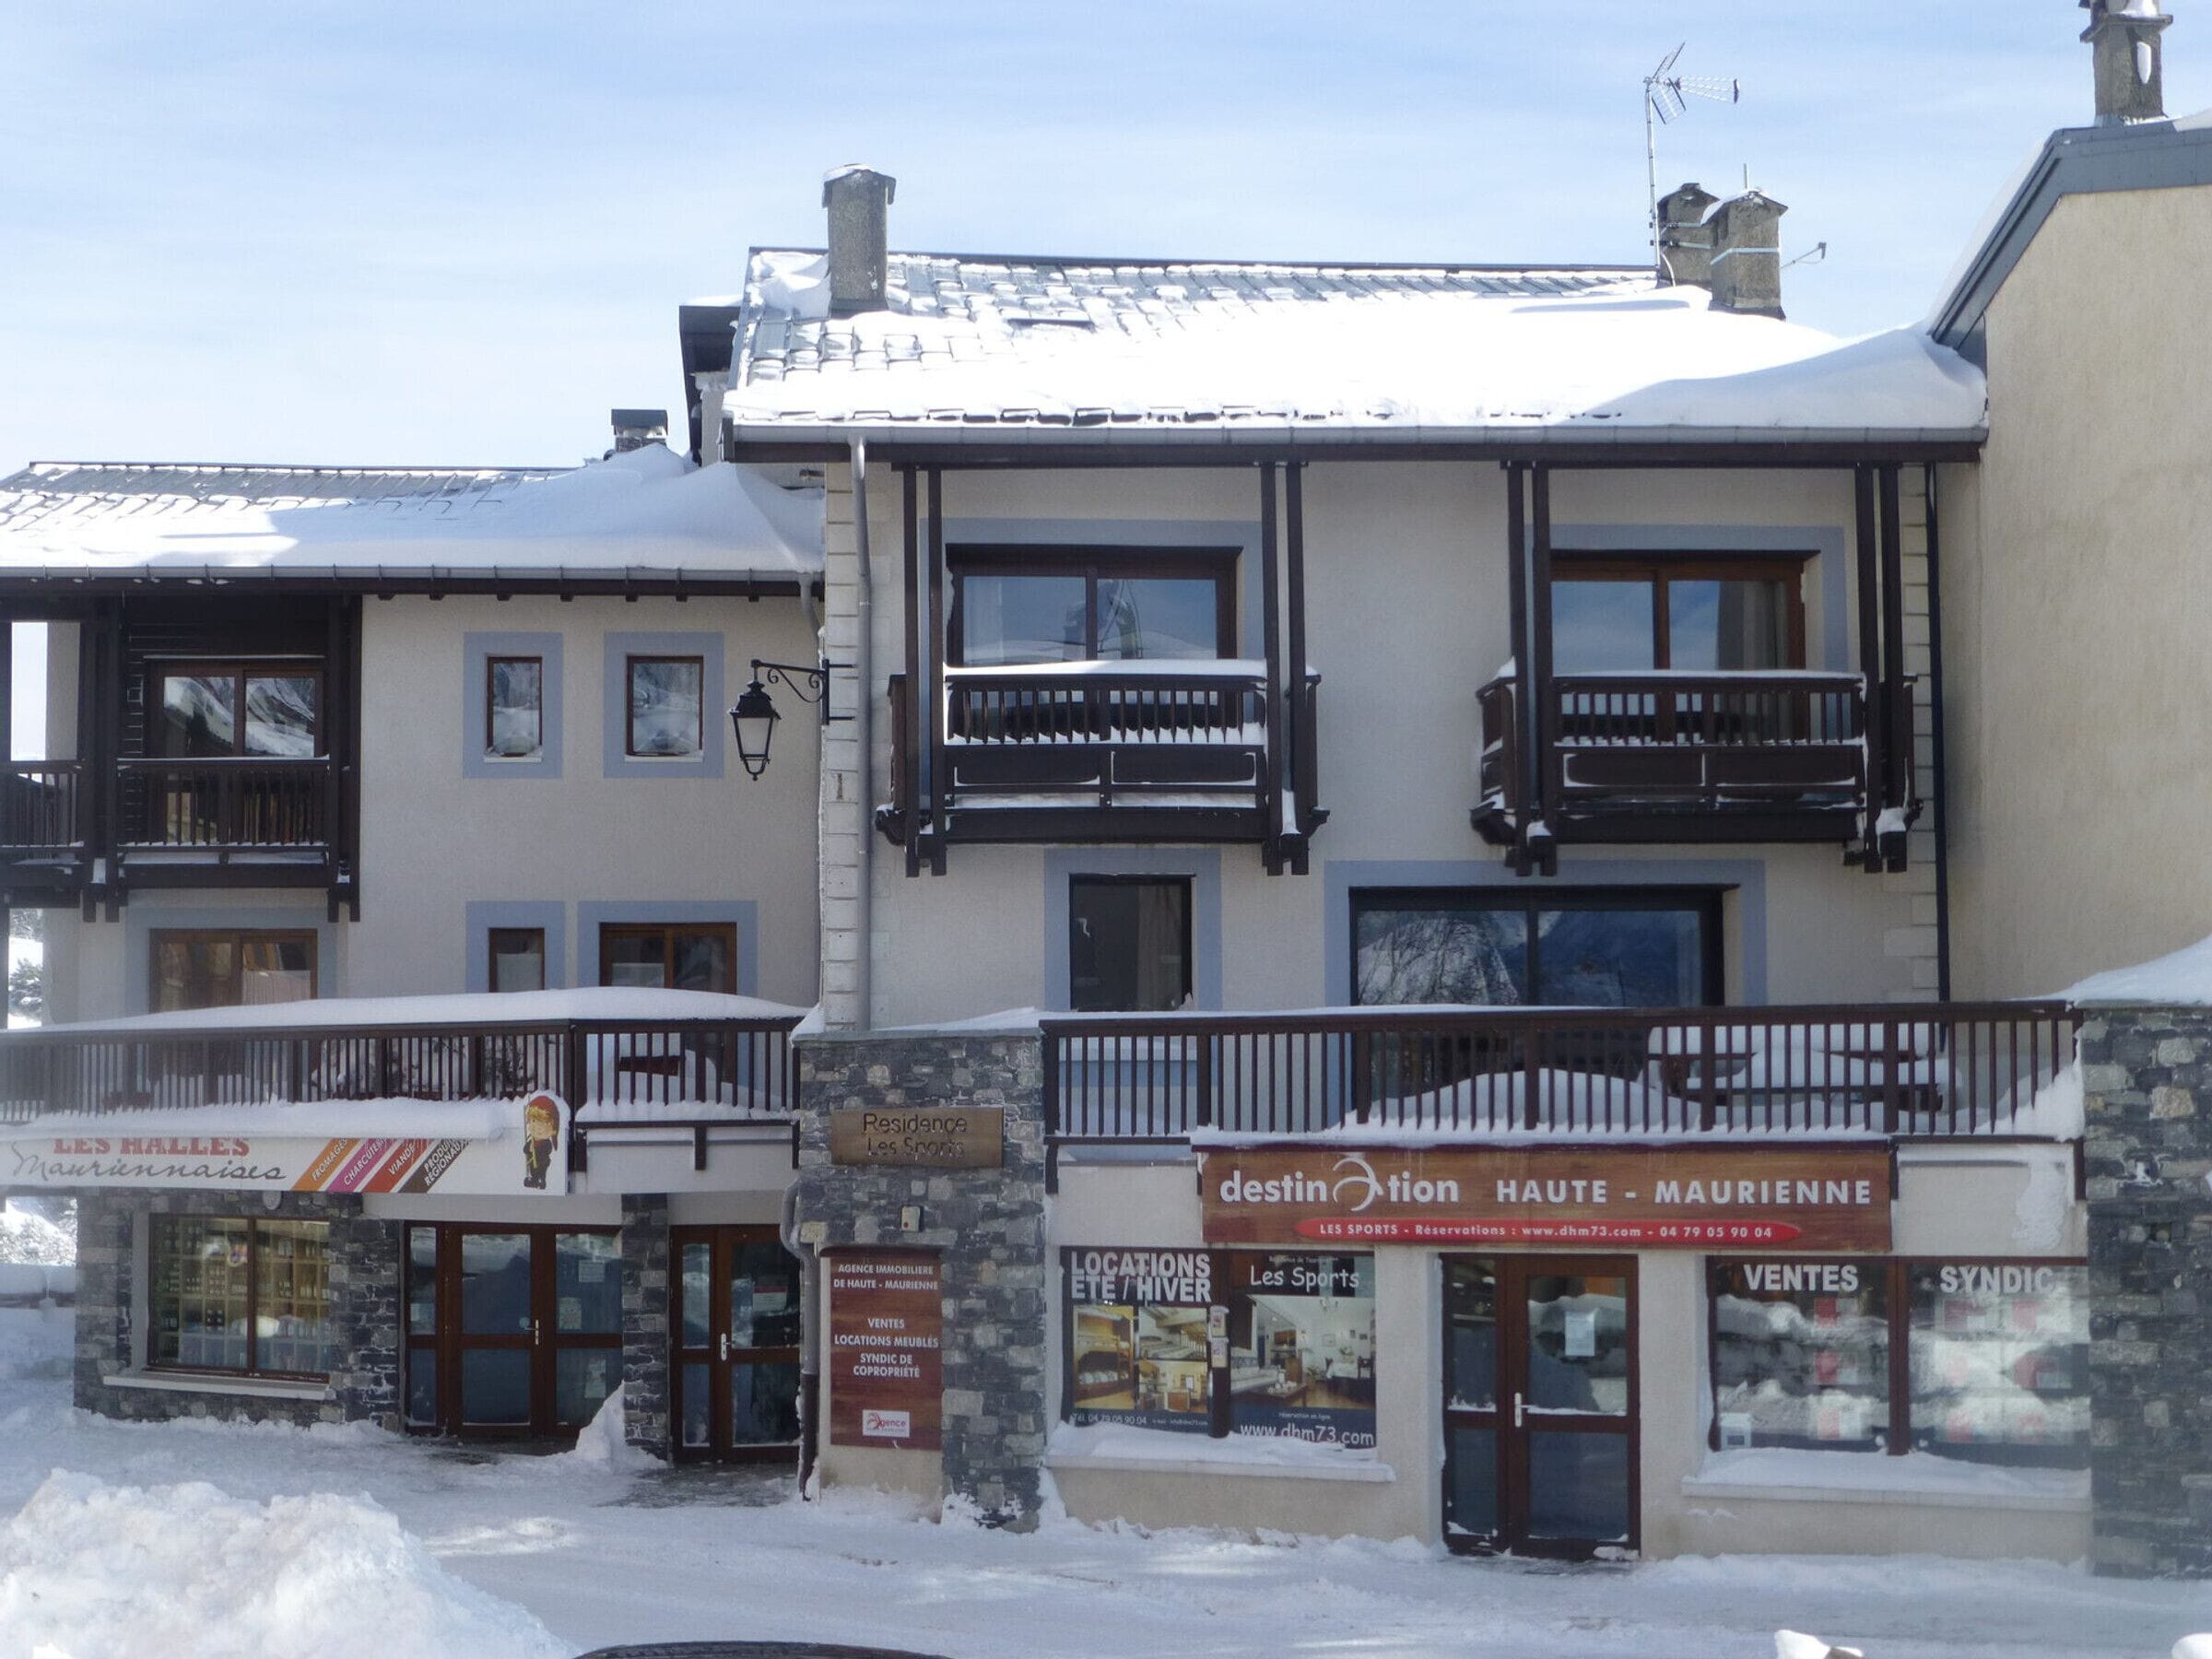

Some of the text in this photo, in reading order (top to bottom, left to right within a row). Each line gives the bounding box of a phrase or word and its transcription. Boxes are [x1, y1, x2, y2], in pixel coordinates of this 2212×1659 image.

[863, 1112, 968, 1134] Residence
[53, 1137, 250, 1157] LES HALLES
[867, 1137, 965, 1159] Les Sports
[1496, 1179, 1607, 1204] HAUTE
[1653, 1180, 1871, 1205] MAURIENNE
[1320, 1223, 1342, 1234] LES
[1347, 1224, 1398, 1235] SPORTS
[1522, 1226, 1641, 1237] www.dhm73.com
[1660, 1227, 1677, 1238] 04
[1684, 1227, 1701, 1238] 79
[1707, 1227, 1724, 1238] 05
[1731, 1228, 1748, 1238] 90
[1755, 1228, 1772, 1239] 04
[838, 1265, 874, 1274] AGENCE
[1070, 1252, 1211, 1277] LOCATIONS
[833, 1278, 845, 1288] DE
[847, 1279, 877, 1289] HAUTE
[885, 1279, 938, 1290] MAURIENNE
[1071, 1275, 1116, 1300] ETE
[1136, 1277, 1211, 1302] HIVER
[1250, 1265, 1359, 1293] Les Sports
[1744, 1265, 1859, 1291] VENTES
[1940, 1266, 2055, 1293] SYNDIC
[867, 1318, 905, 1329] VENTES
[834, 1335, 891, 1347] LOCATIONS
[860, 1353, 912, 1365] SYNDIC DE
